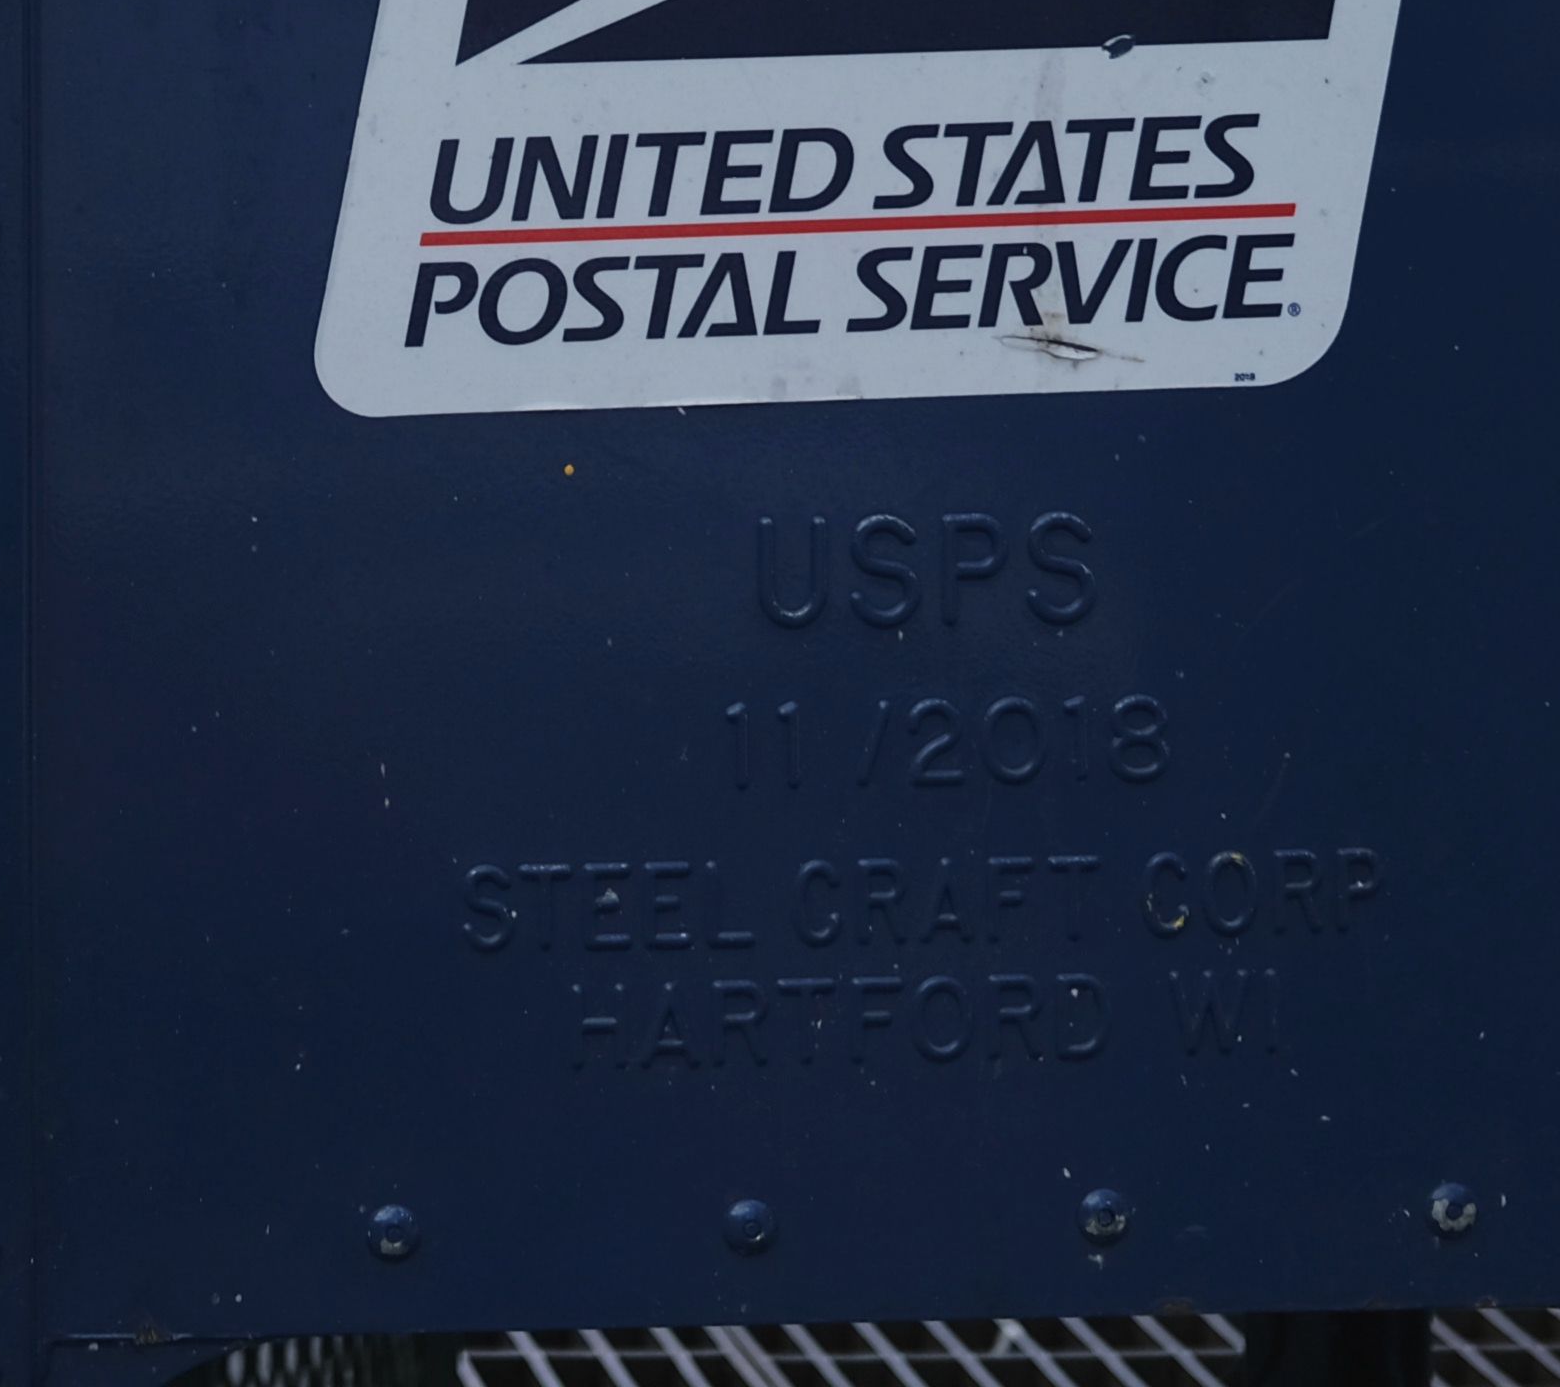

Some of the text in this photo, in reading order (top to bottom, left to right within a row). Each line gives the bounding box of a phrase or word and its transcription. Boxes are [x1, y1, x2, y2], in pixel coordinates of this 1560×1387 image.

[428, 113, 1261, 225] UNITED STATES
[404, 233, 1295, 348] POSTAL SERVICE
[757, 511, 1097, 629] USPS
[461, 845, 1387, 953] STEEL CRAFT CORP
[568, 967, 1278, 1072] HARTFORD WI
